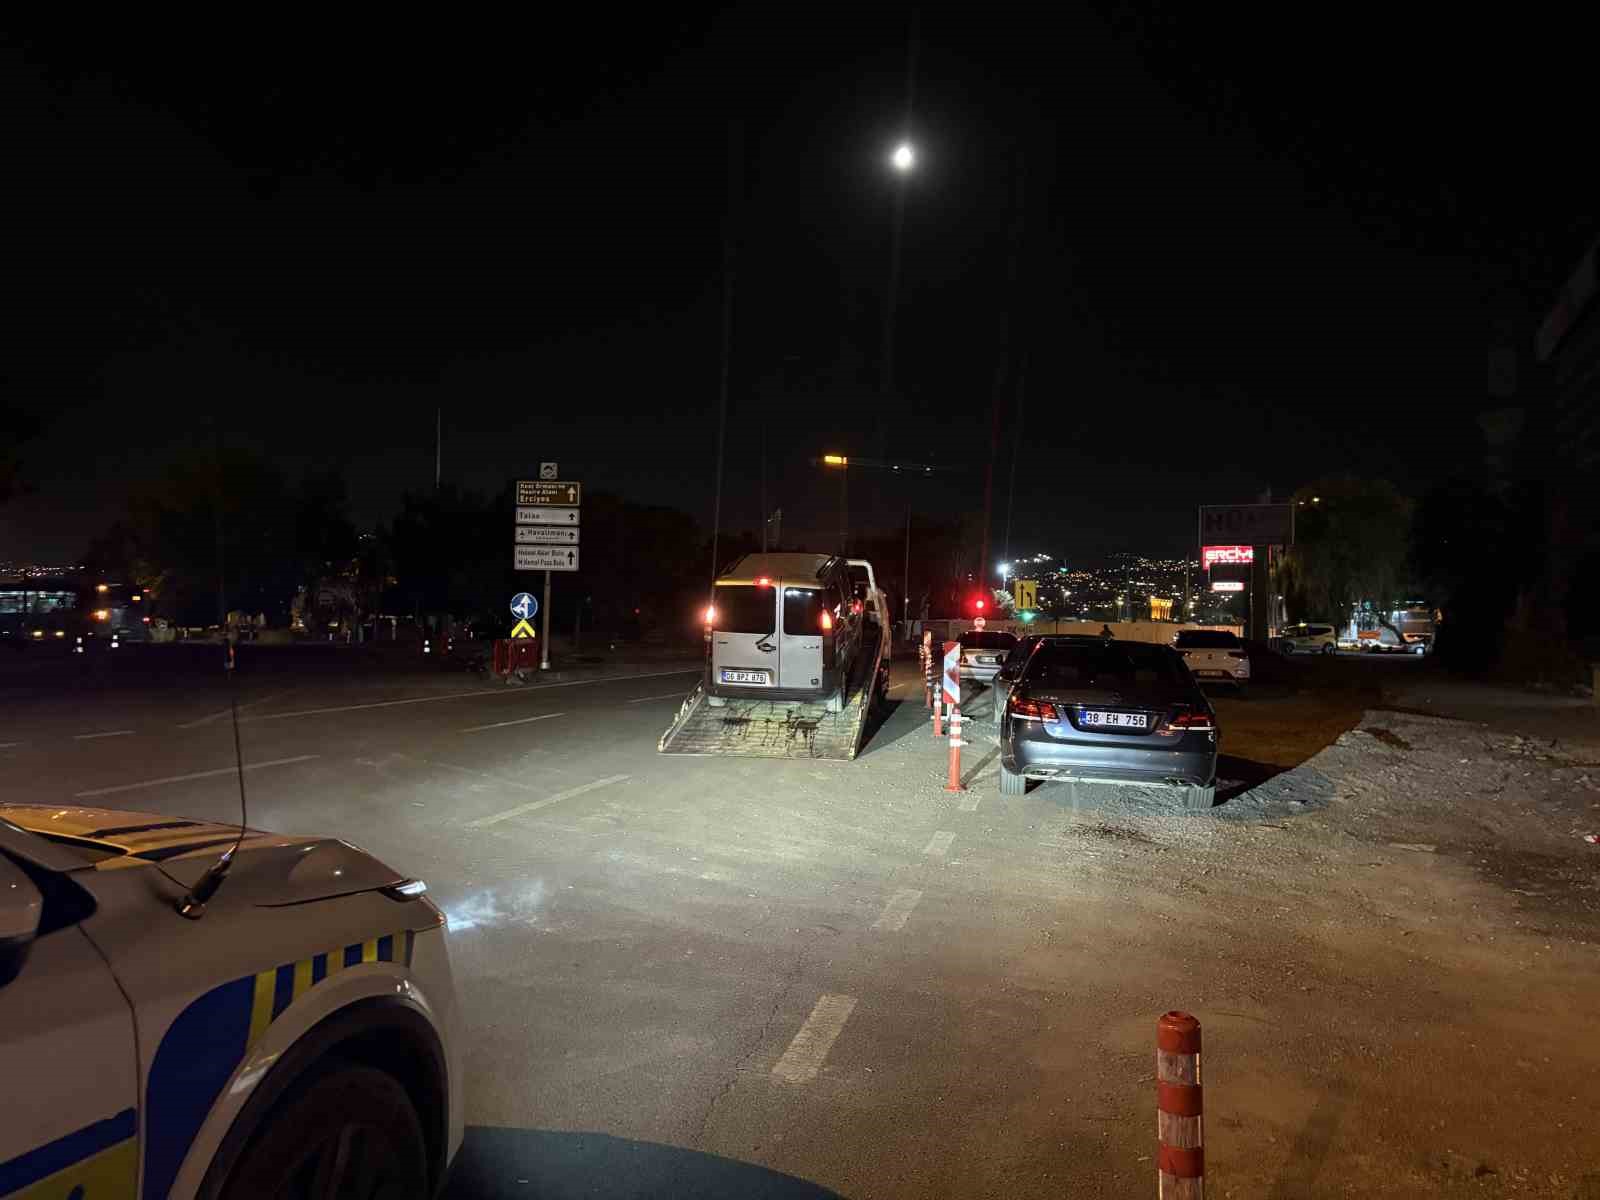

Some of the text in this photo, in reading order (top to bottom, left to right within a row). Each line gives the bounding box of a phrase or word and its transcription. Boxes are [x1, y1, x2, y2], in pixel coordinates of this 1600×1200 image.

[1087, 713, 1145, 726] 38 EH 756
